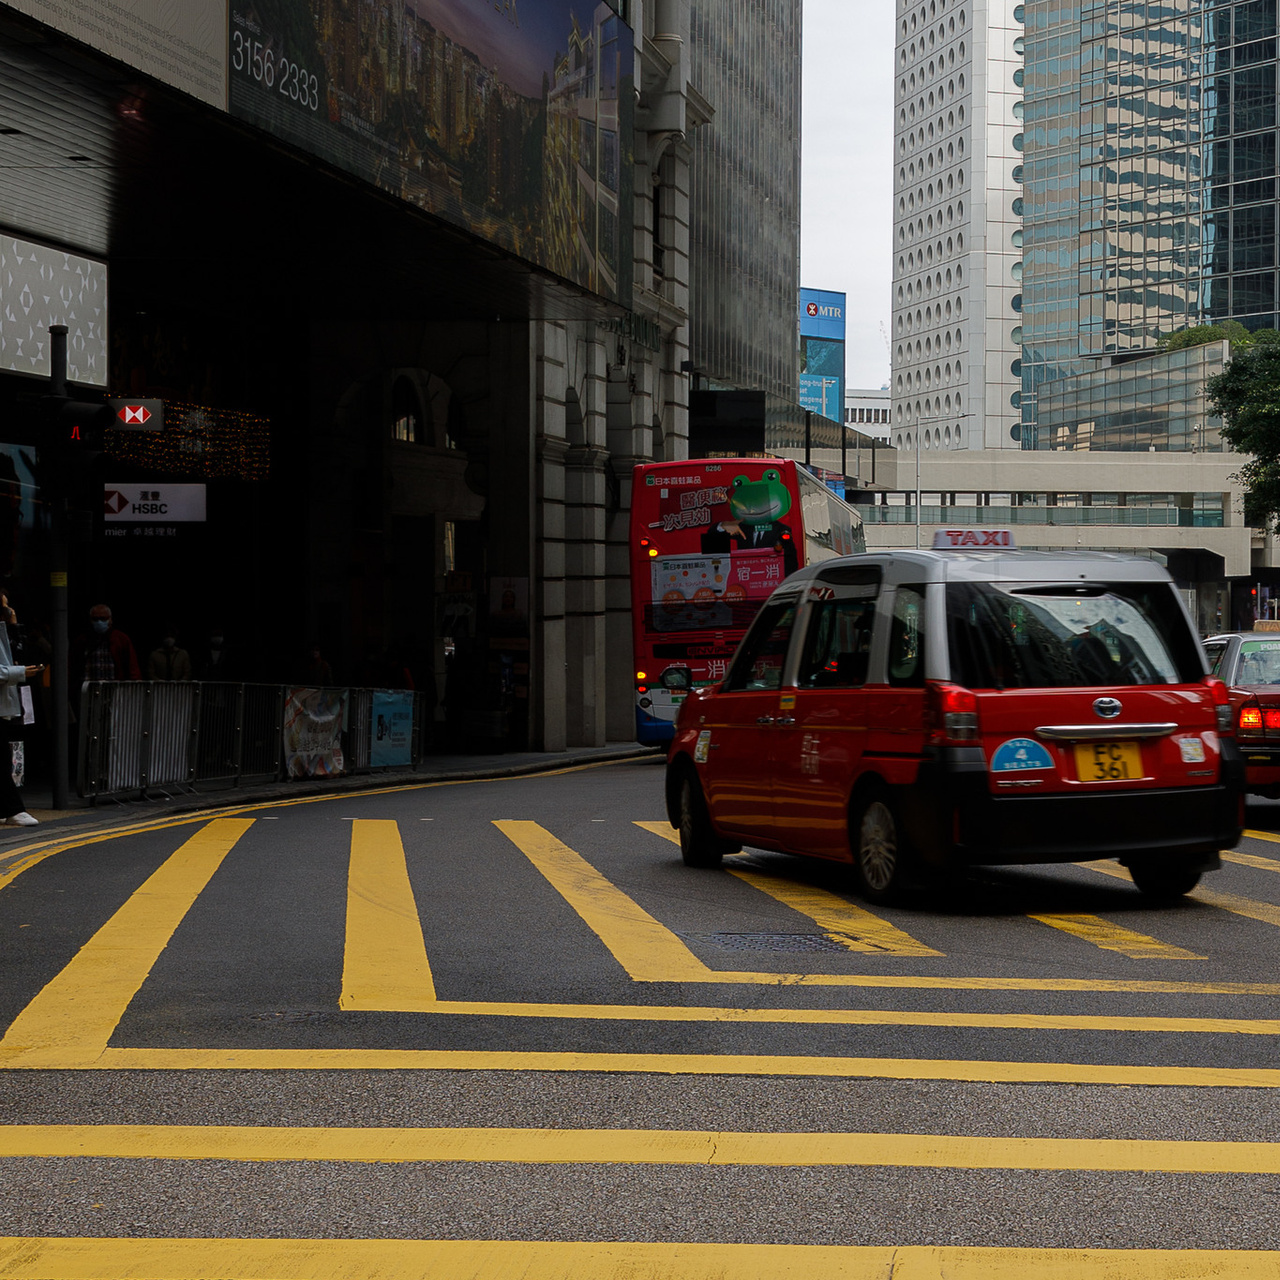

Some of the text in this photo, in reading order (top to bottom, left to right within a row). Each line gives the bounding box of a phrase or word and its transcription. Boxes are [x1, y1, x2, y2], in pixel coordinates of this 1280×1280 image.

[233, 30, 275, 88] 3156
[279, 58, 319, 111] 2333
[819, 305, 842, 319] MTR
[132, 503, 168, 514] HSBC
[105, 527, 127, 536] mier
[946, 530, 1010, 546] TAXI
[1014, 748, 1029, 761] 4
[1092, 745, 1123, 762] FC
[1003, 760, 1042, 769] SEATS
[1093, 762, 1129, 779] 361
